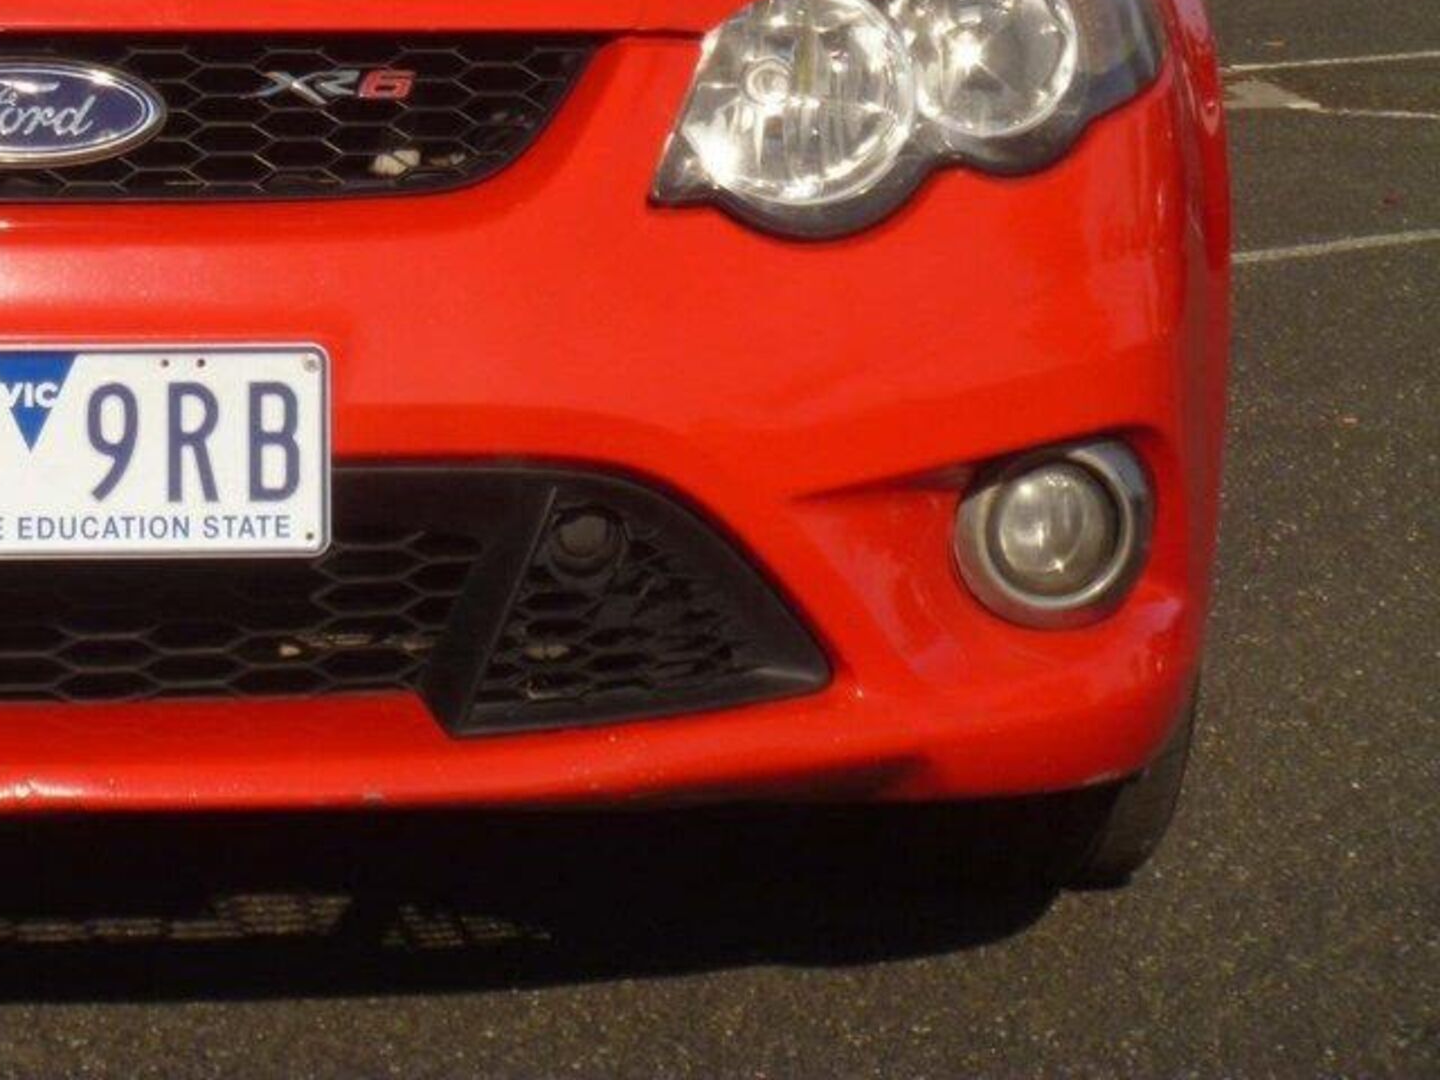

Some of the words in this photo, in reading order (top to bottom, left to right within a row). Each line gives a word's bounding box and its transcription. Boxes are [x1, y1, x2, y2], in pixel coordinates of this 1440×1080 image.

[242, 69, 416, 104] XR6
[87, 381, 300, 502] 9RB
[17, 516, 190, 539] EDUCATION
[203, 515, 291, 538] STATE
